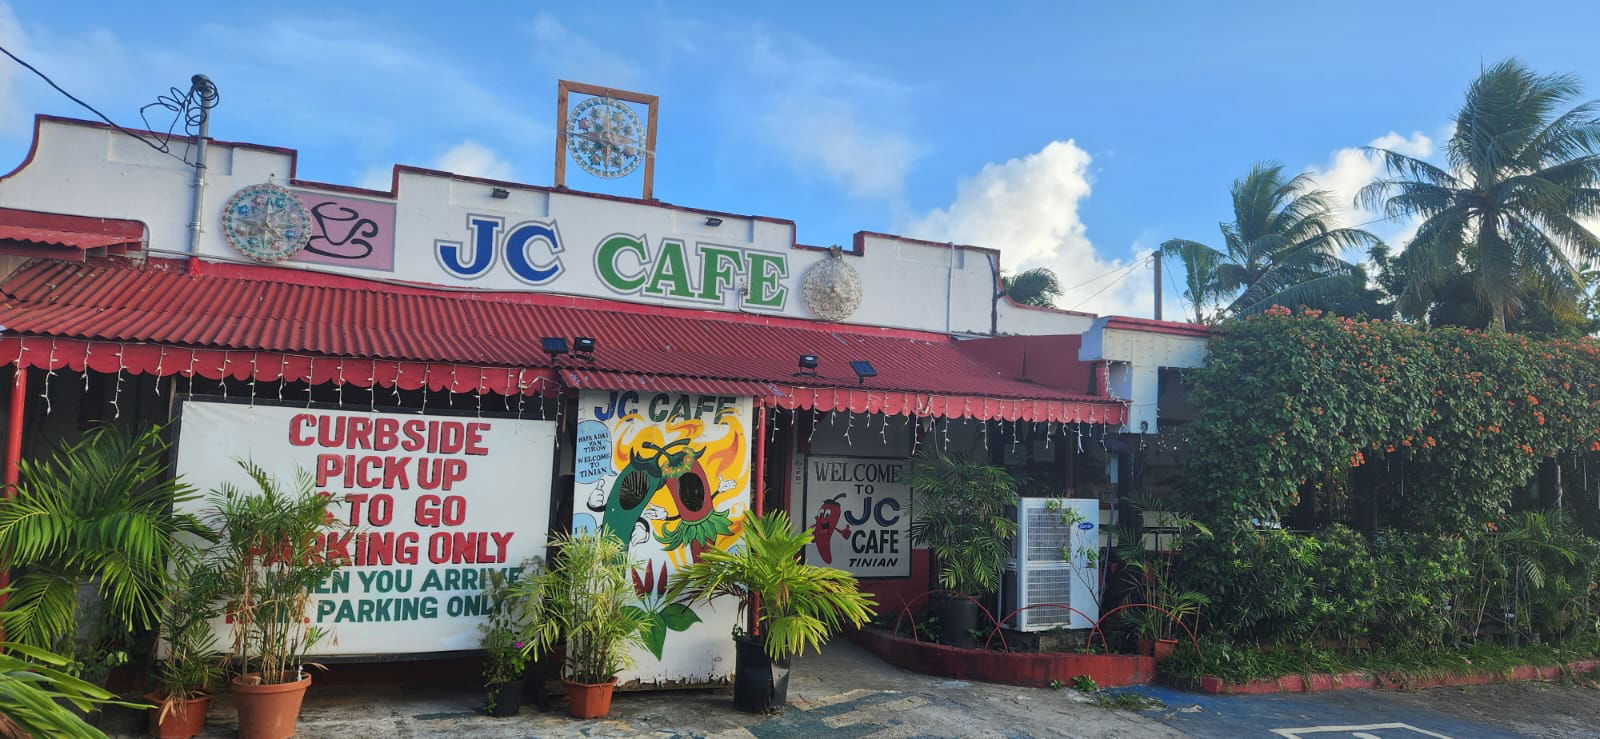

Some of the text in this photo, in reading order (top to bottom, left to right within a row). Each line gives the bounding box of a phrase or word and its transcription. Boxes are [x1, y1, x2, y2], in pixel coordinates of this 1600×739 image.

[434, 213, 789, 312] JC CAFE
[594, 389, 640, 422] JC
[288, 413, 491, 456] CURBSIDE
[316, 453, 468, 491] PICK UP
[590, 461, 600, 469] TO
[814, 461, 903, 483] WELCOME
[854, 484, 875, 495] TO
[345, 493, 394, 527] TO
[414, 494, 466, 527] GO
[844, 496, 901, 527] JC
[428, 531, 515, 565] ONLY
[851, 529, 899, 554] CAFE
[848, 558, 899, 568] TINIAN
[358, 569, 413, 595] YOU
[316, 596, 438, 623] PARKING
[446, 593, 507, 617] ONL
